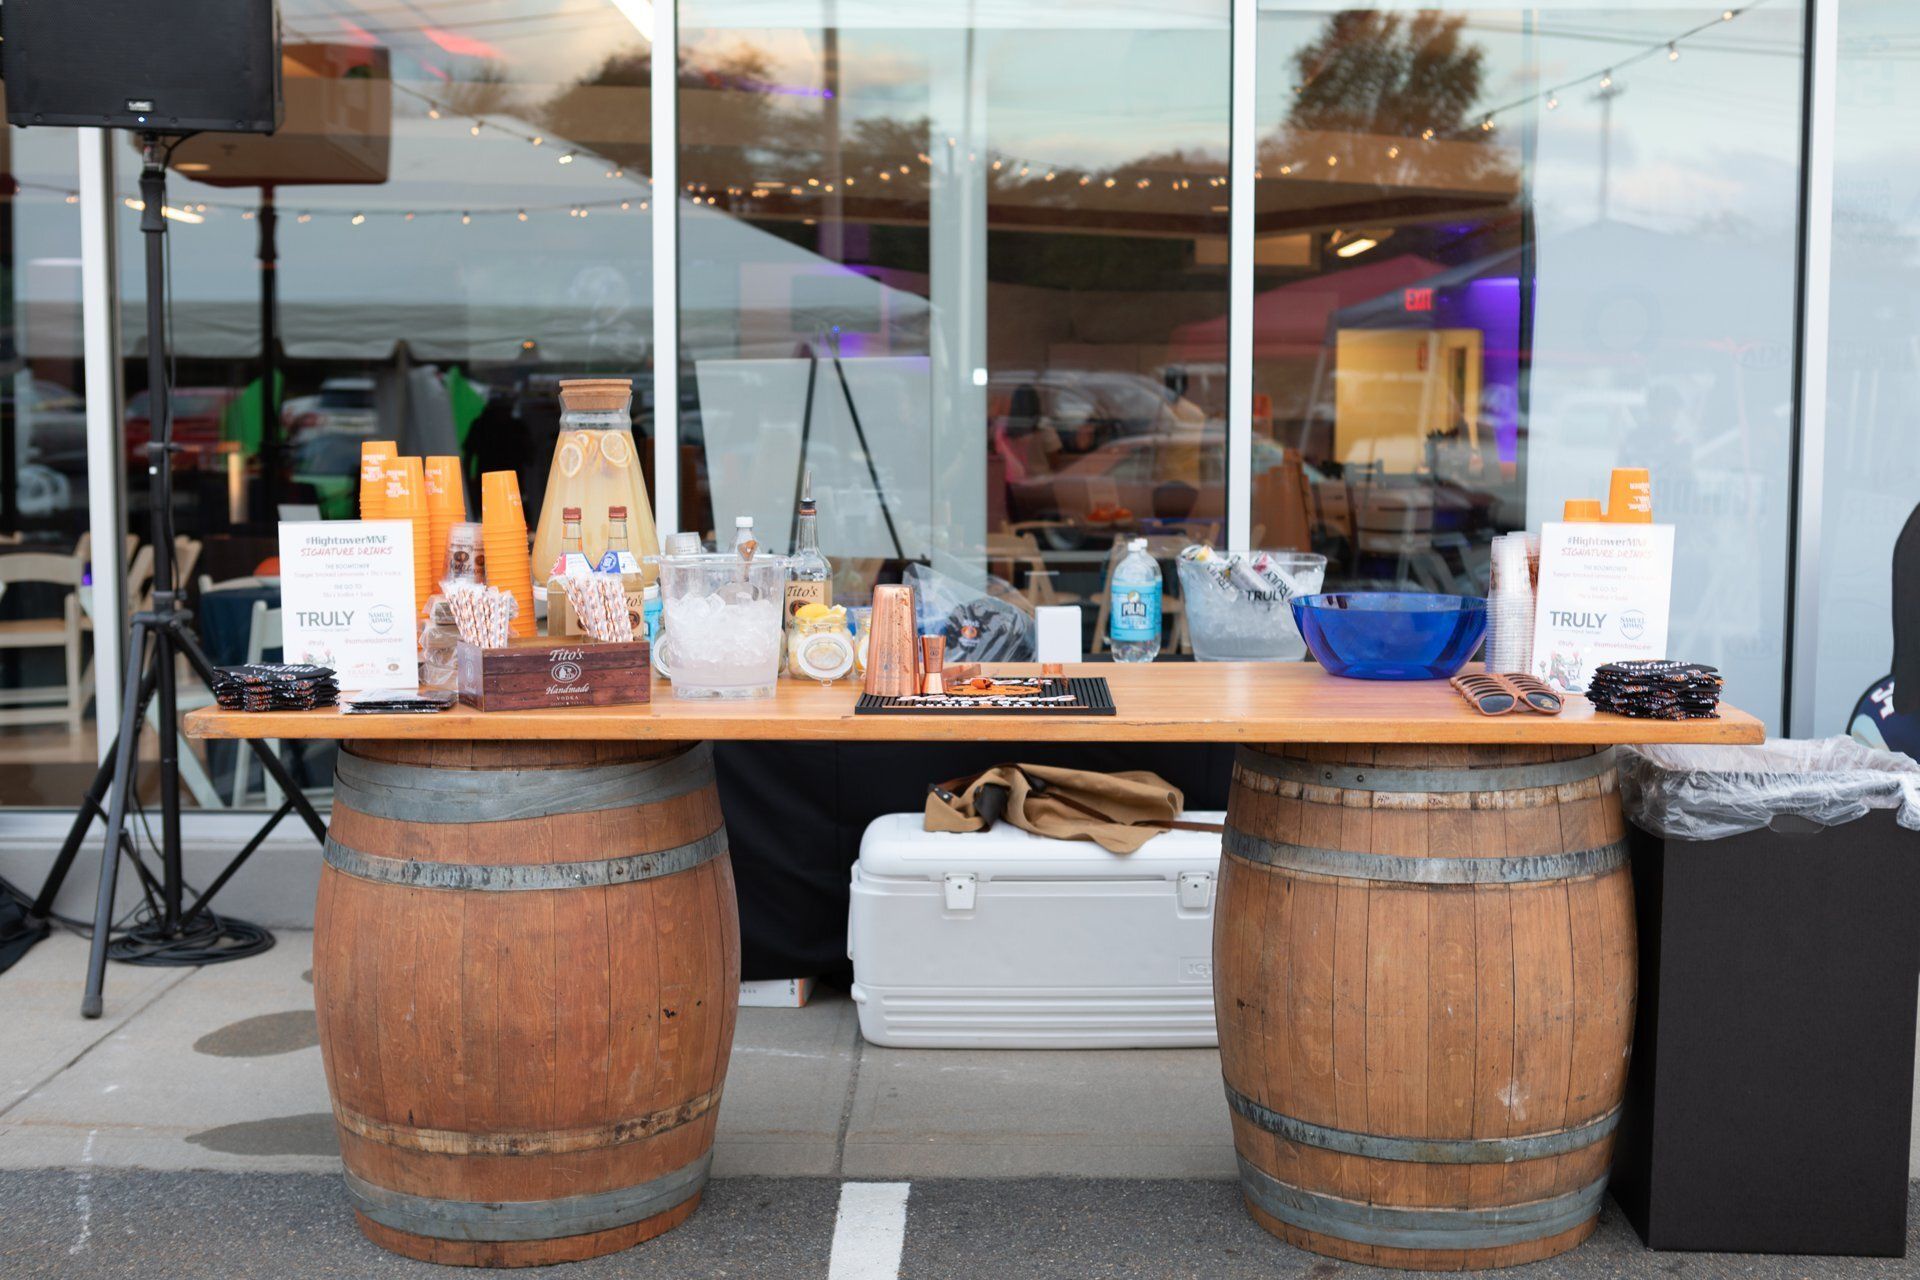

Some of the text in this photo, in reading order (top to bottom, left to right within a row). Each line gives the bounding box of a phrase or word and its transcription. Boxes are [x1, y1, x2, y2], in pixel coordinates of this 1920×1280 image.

[300, 546, 393, 557] SIGNATURE DRINKS
[787, 585, 818, 598] Tito's
[1246, 589, 1286, 602] TRULY
[1121, 601, 1147, 617] POLAR
[296, 610, 355, 628] TRULY
[1549, 610, 1608, 629] TRULY
[549, 647, 585, 662] Tito's
[545, 682, 591, 695] Handmade
